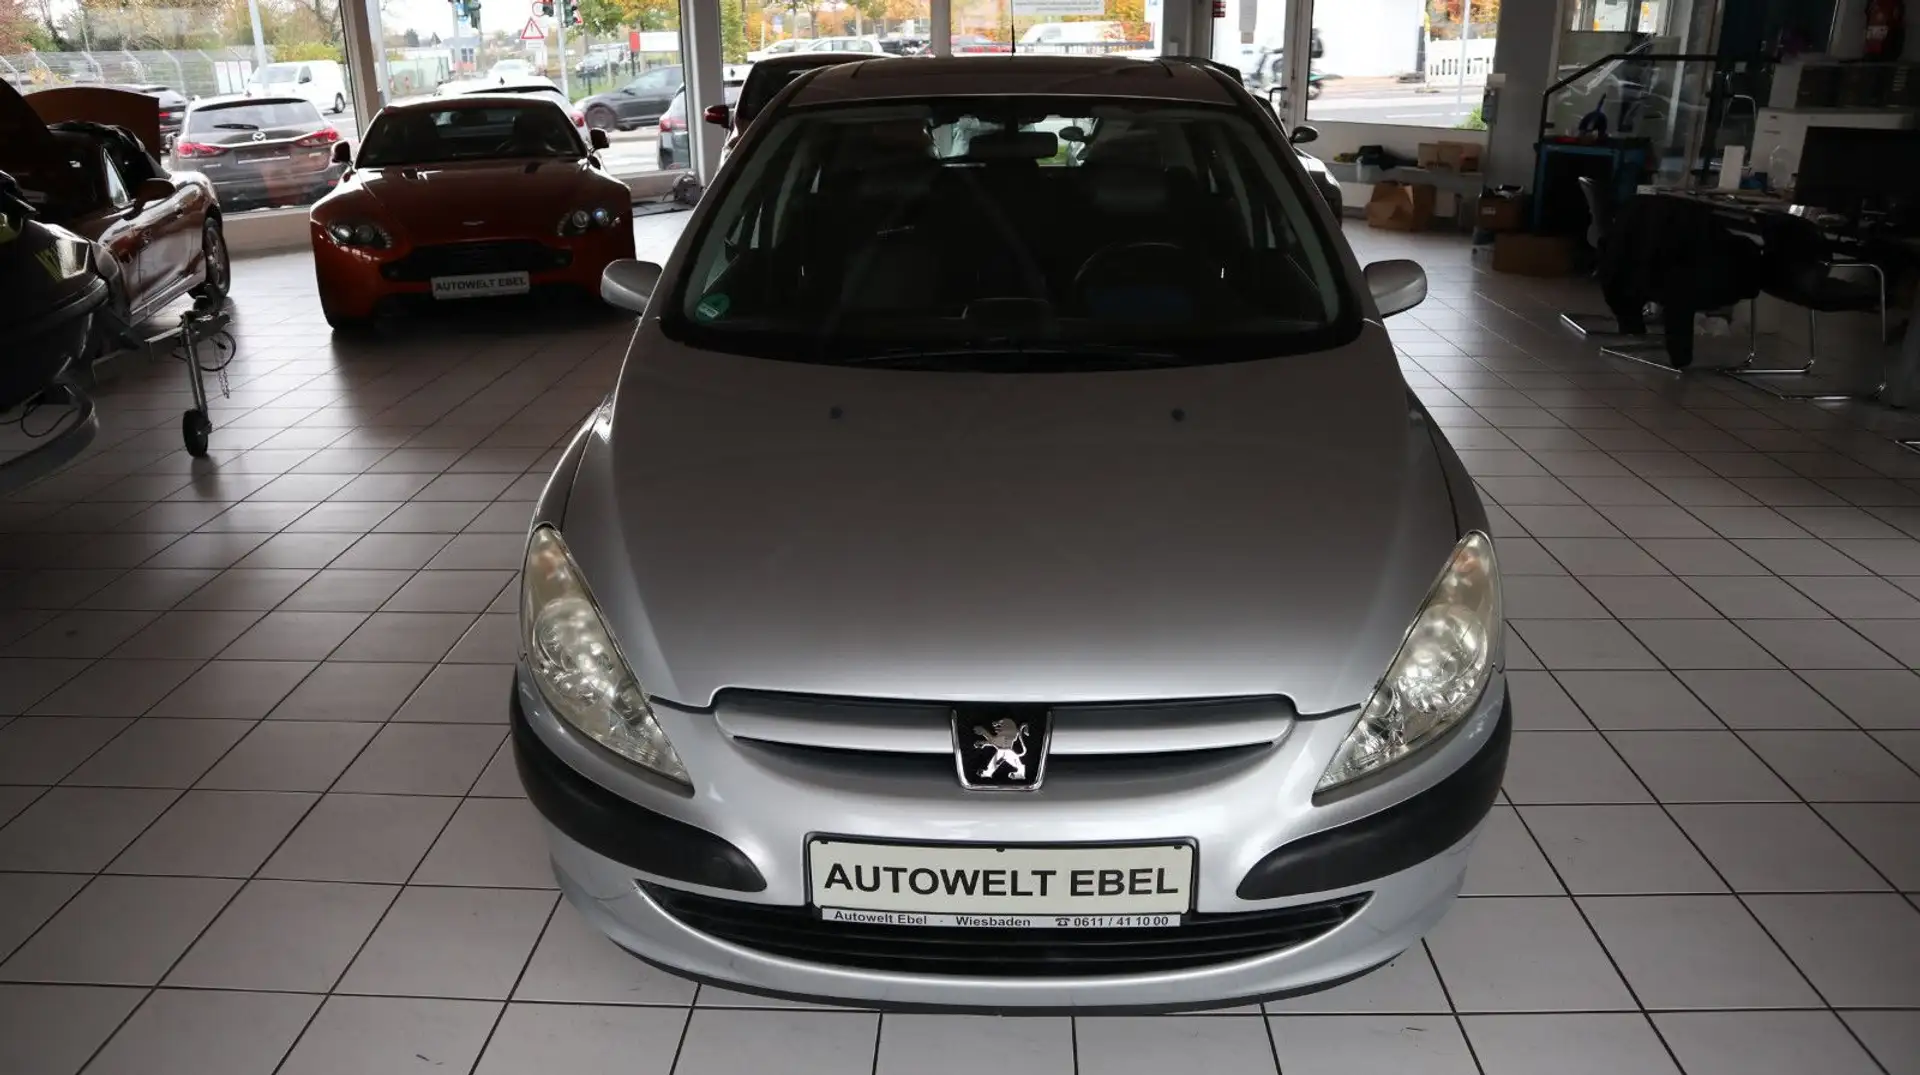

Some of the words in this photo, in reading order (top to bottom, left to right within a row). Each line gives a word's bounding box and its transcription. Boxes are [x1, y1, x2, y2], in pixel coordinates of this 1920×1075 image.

[824, 863, 1057, 896] AUTOWELT
[1070, 868, 1179, 897] EBEL
[834, 910, 894, 925] Autowelt
[898, 914, 927, 925] Ebel
[956, 916, 1031, 927] Wiesbaden
[1074, 917, 1104, 927] 0611
[1117, 917, 1135, 927] 41
[1137, 917, 1150, 927] 10
[1153, 916, 1169, 926] 00
